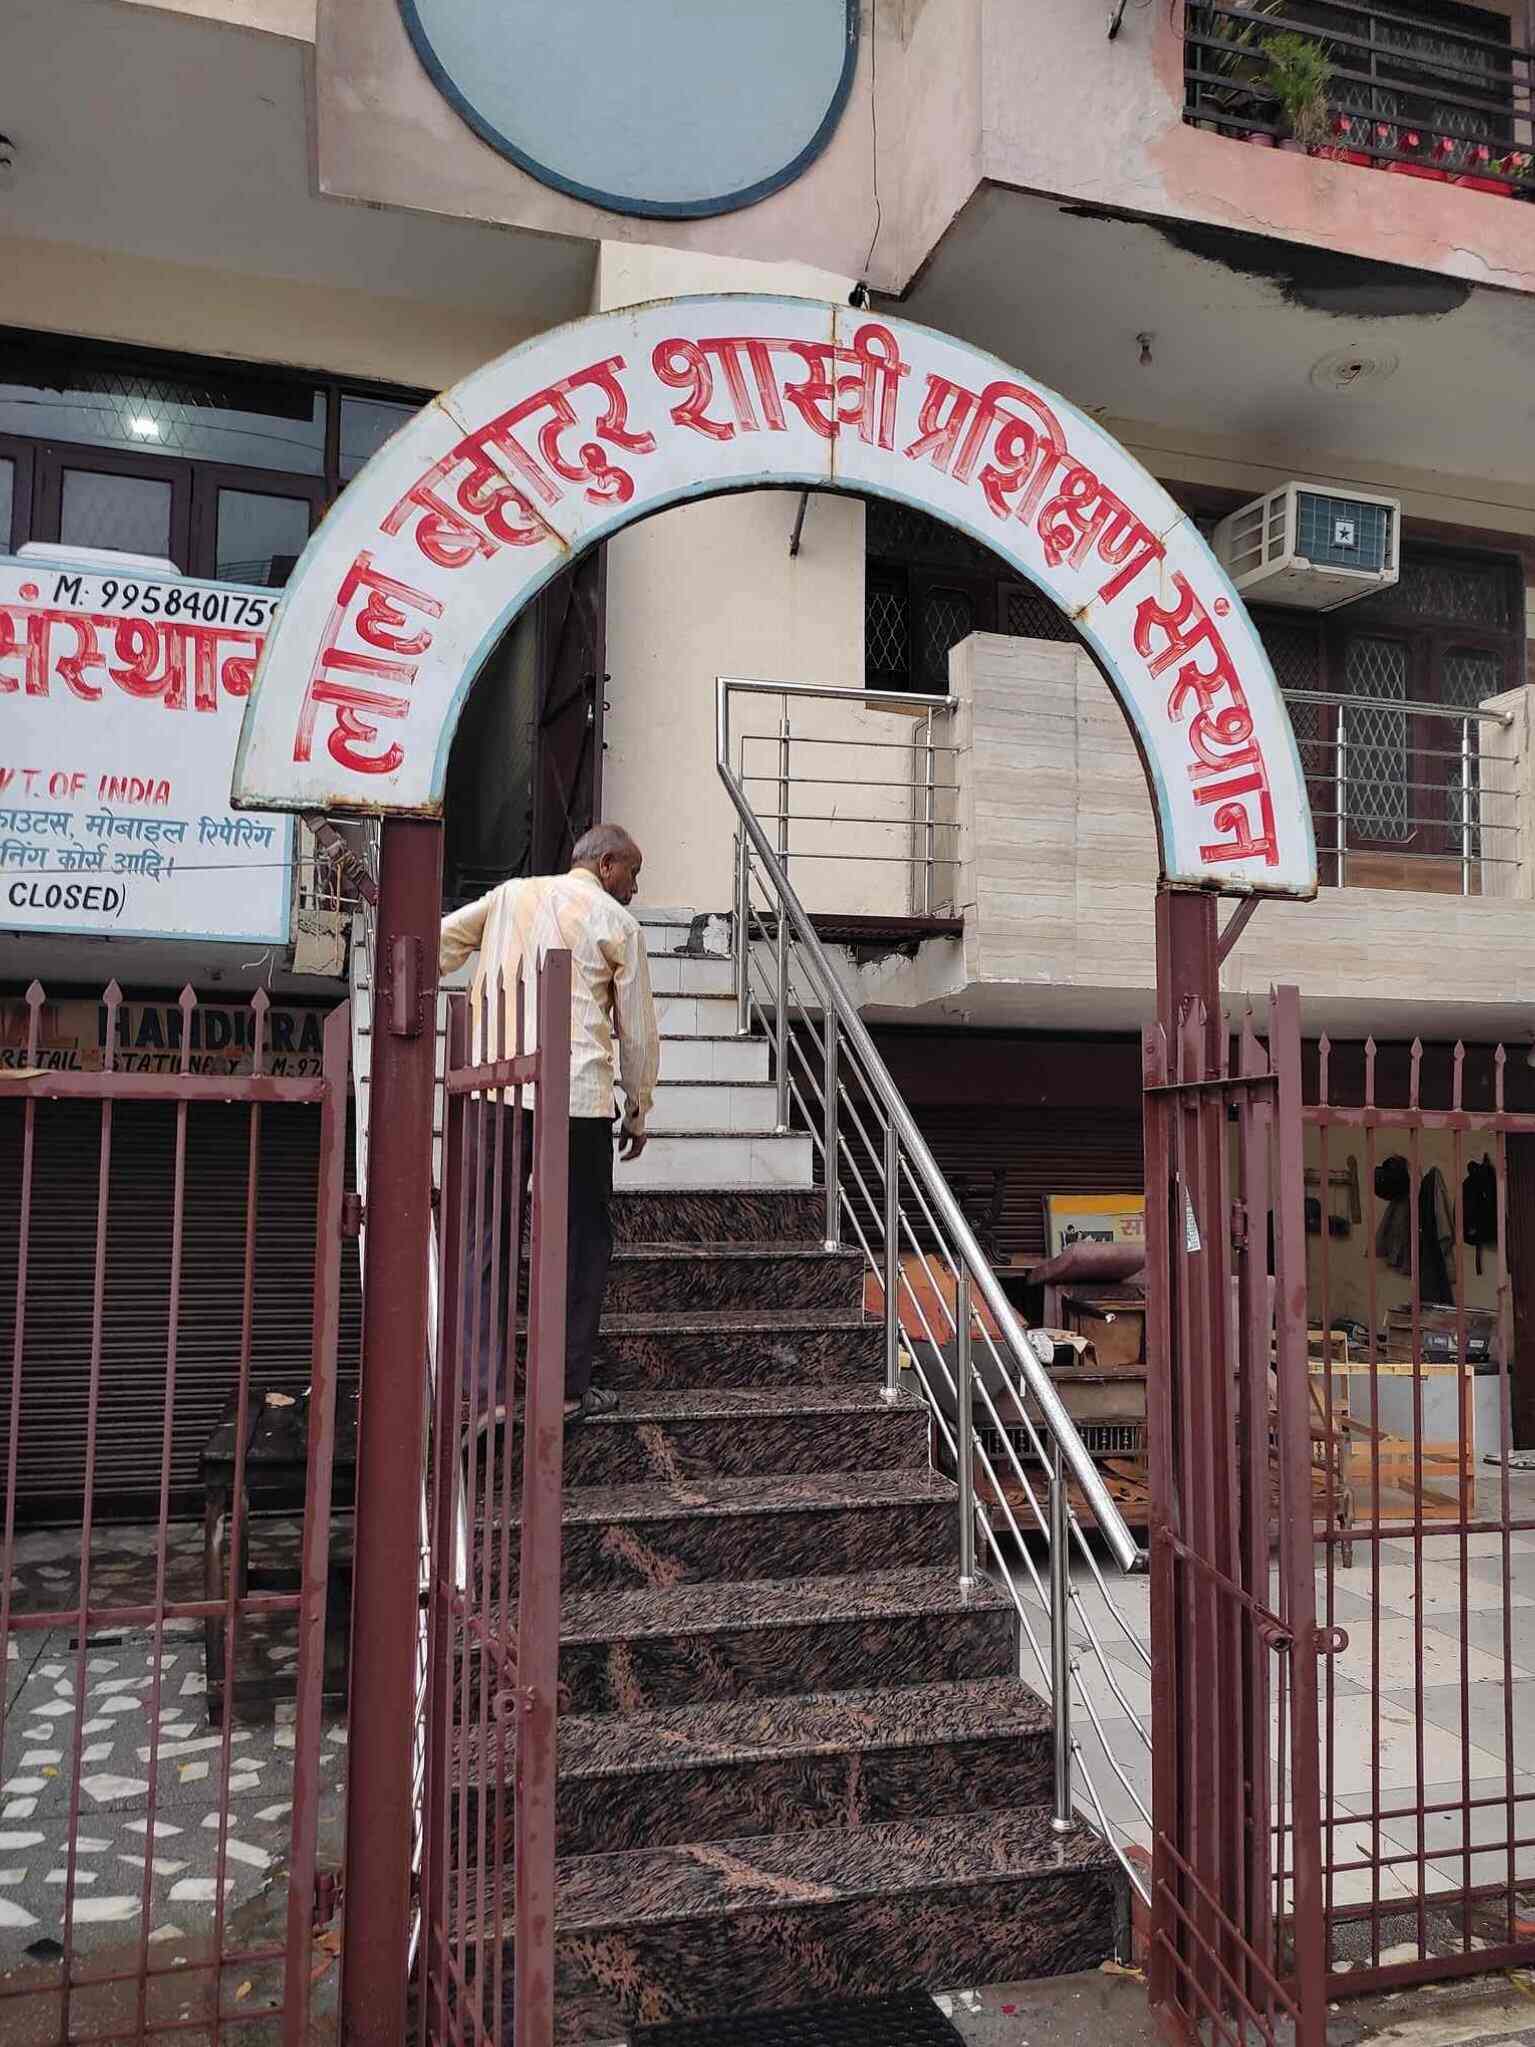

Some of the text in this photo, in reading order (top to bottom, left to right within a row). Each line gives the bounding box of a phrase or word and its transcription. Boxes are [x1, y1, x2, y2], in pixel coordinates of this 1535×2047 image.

[293, 549, 444, 775] लाल
[380, 355, 656, 569] बहादुर
[902, 373, 1168, 604] प्रशिक्षण
[1133, 569, 1280, 867] संस्थान
[97, 774, 172, 806] INDIA
[85, 806, 189, 848] मोबाइल
[8, 882, 126, 918] CLOSED)
